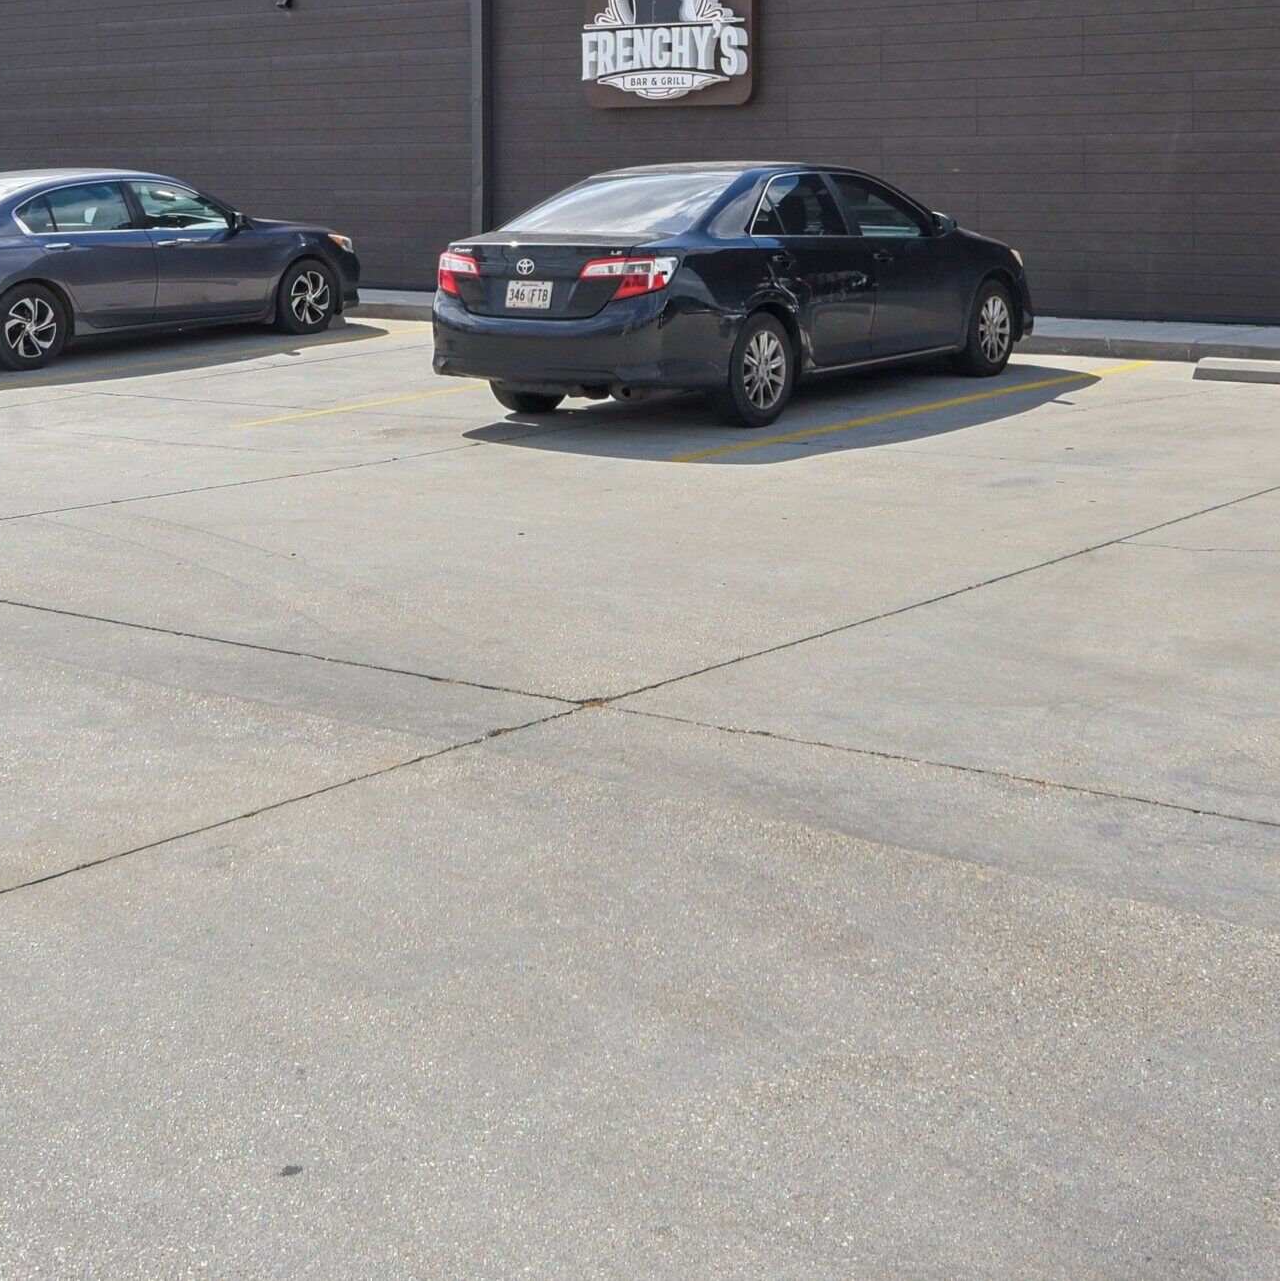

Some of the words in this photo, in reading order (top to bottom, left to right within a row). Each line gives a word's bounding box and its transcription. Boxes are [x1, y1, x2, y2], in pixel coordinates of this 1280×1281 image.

[582, 19, 748, 81] FRENCHY'S
[630, 77, 648, 87] BAR
[652, 76, 658, 86] &
[661, 76, 687, 86] GRILL
[508, 288, 526, 301] 346
[530, 289, 549, 302] FTB
